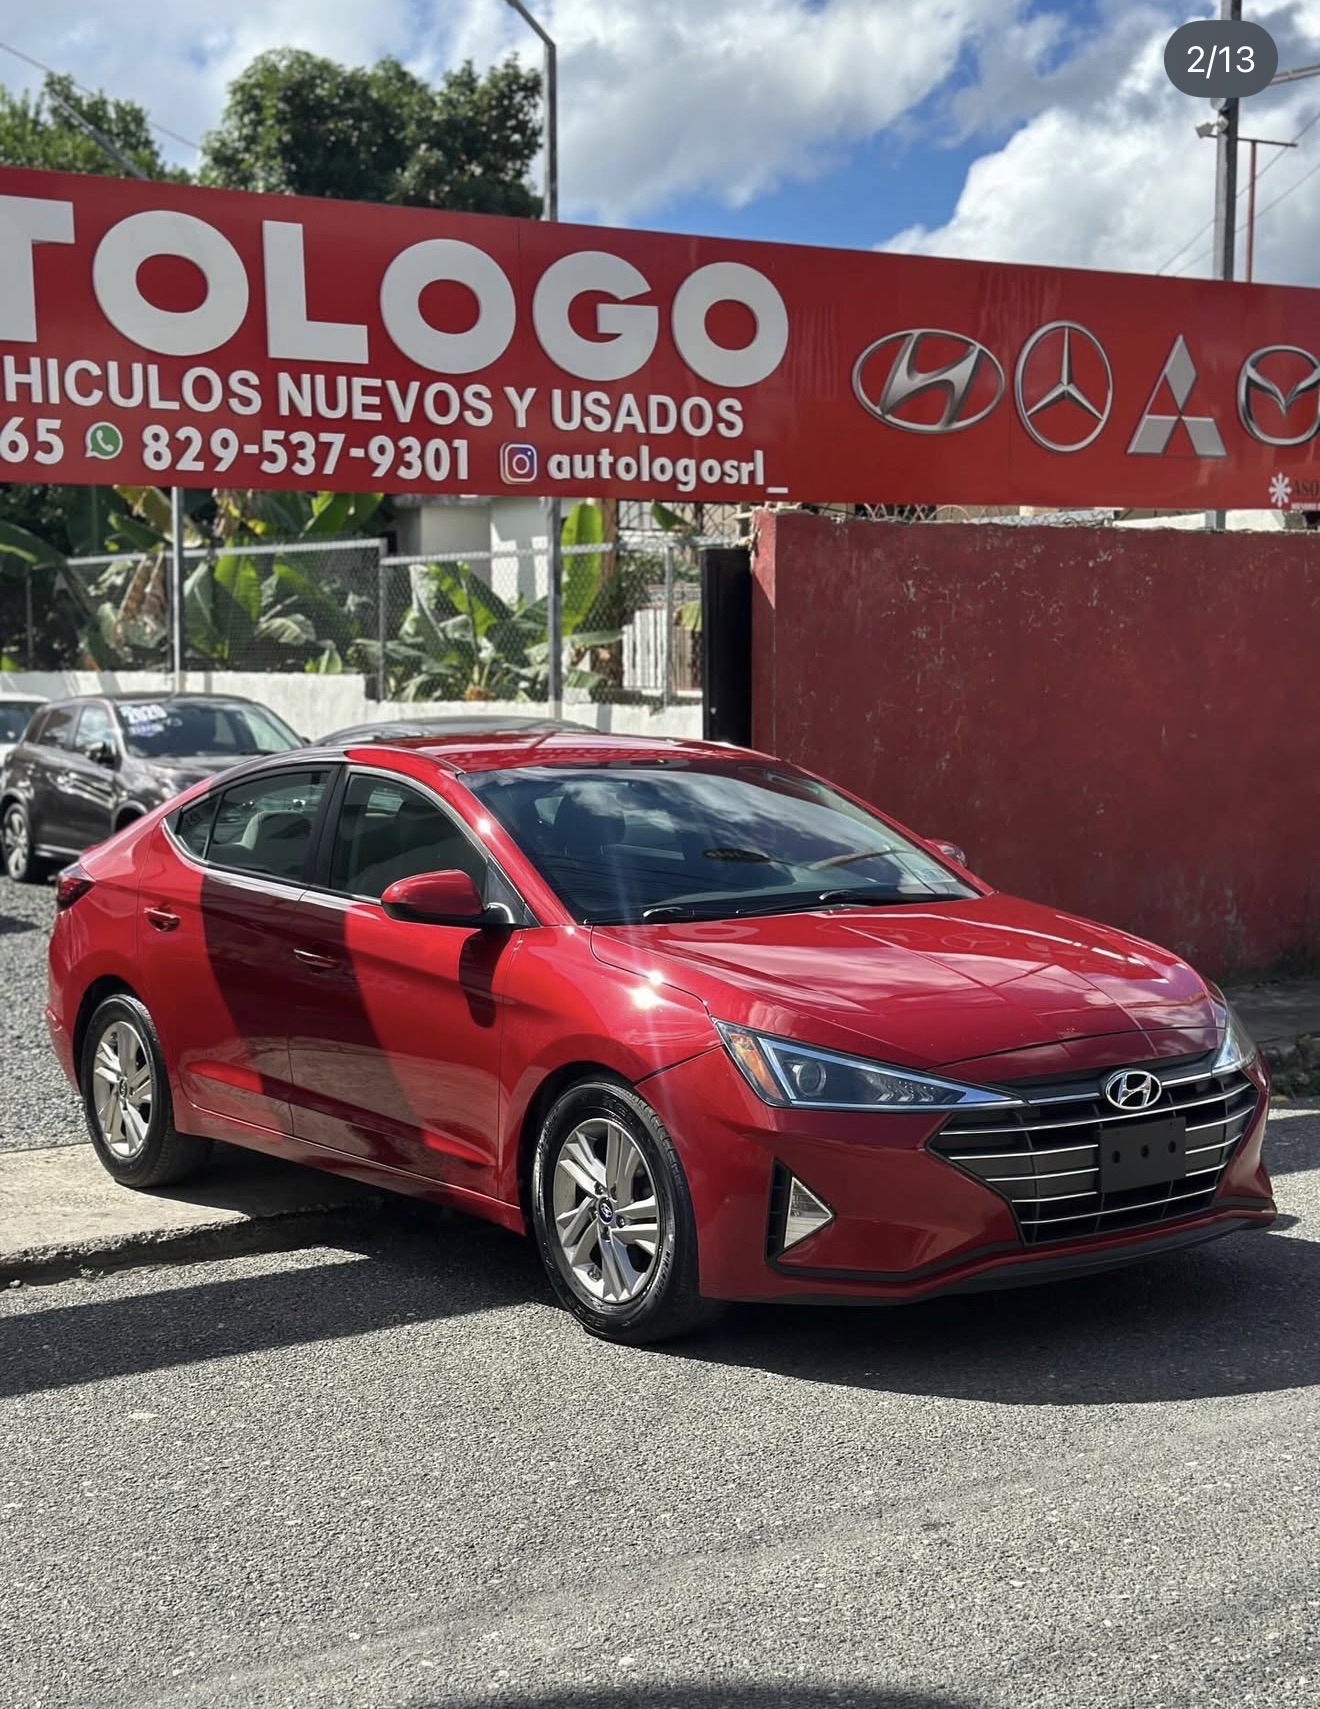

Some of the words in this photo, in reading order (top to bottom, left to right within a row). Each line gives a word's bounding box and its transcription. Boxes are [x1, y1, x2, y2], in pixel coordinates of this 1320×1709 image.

[3, 355, 262, 415] HICULOS
[278, 372, 494, 426] NUEVOS
[504, 387, 537, 428] Y
[552, 389, 744, 438] USADOS
[0, 416, 64, 464] 65
[142, 424, 468, 480] 829-537-9301
[547, 445, 789, 493] autologosrl_
